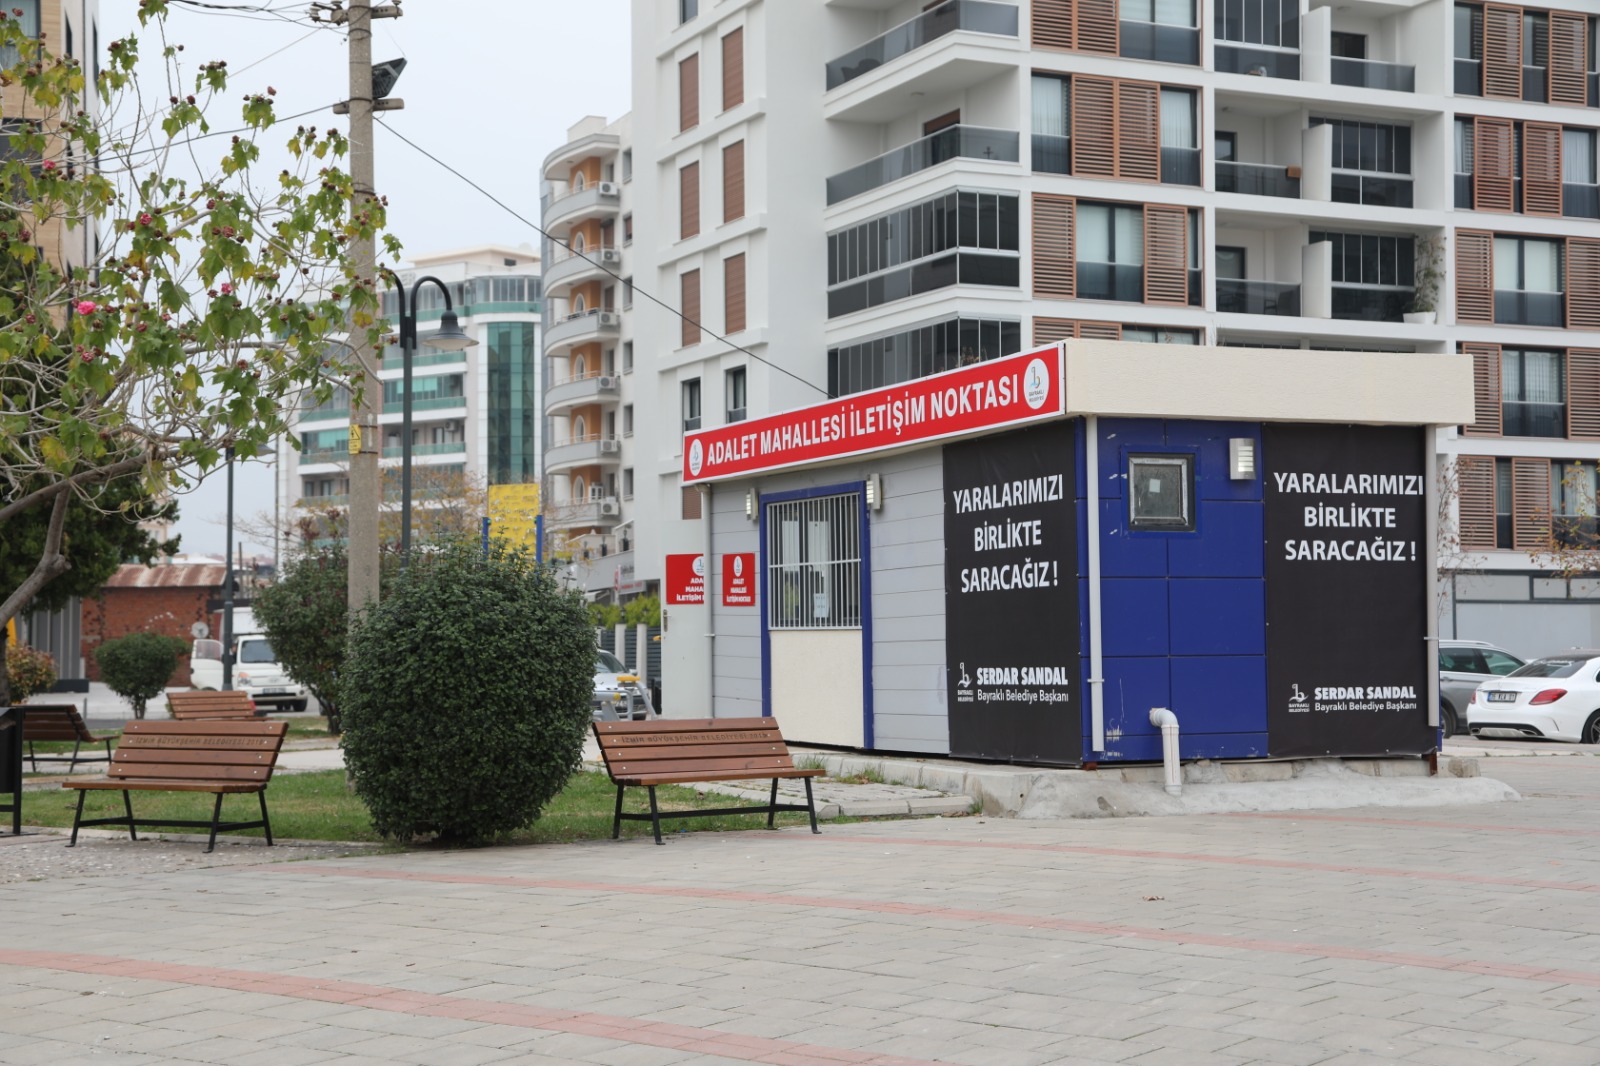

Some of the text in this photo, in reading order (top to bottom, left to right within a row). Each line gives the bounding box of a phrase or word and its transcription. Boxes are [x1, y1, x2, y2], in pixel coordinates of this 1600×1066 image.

[707, 374, 1018, 466] ADALET MAHALLESİ İLETİŞİM NOKTASI
[953, 474, 1063, 514] YARALARIMIZI
[1273, 472, 1424, 495] YARALARIMIZI
[1304, 502, 1397, 528] BİRLİKTE
[974, 518, 1041, 552] BİRLİKTE
[976, 666, 1069, 686] SERDAR SANDAL
[977, 689, 1069, 705] Bayraklı Belediye Başkanı
[1314, 686, 1417, 700] SERDAR SANDAL
[1315, 701, 1417, 713] Bayraklı Belediye Başkanı
